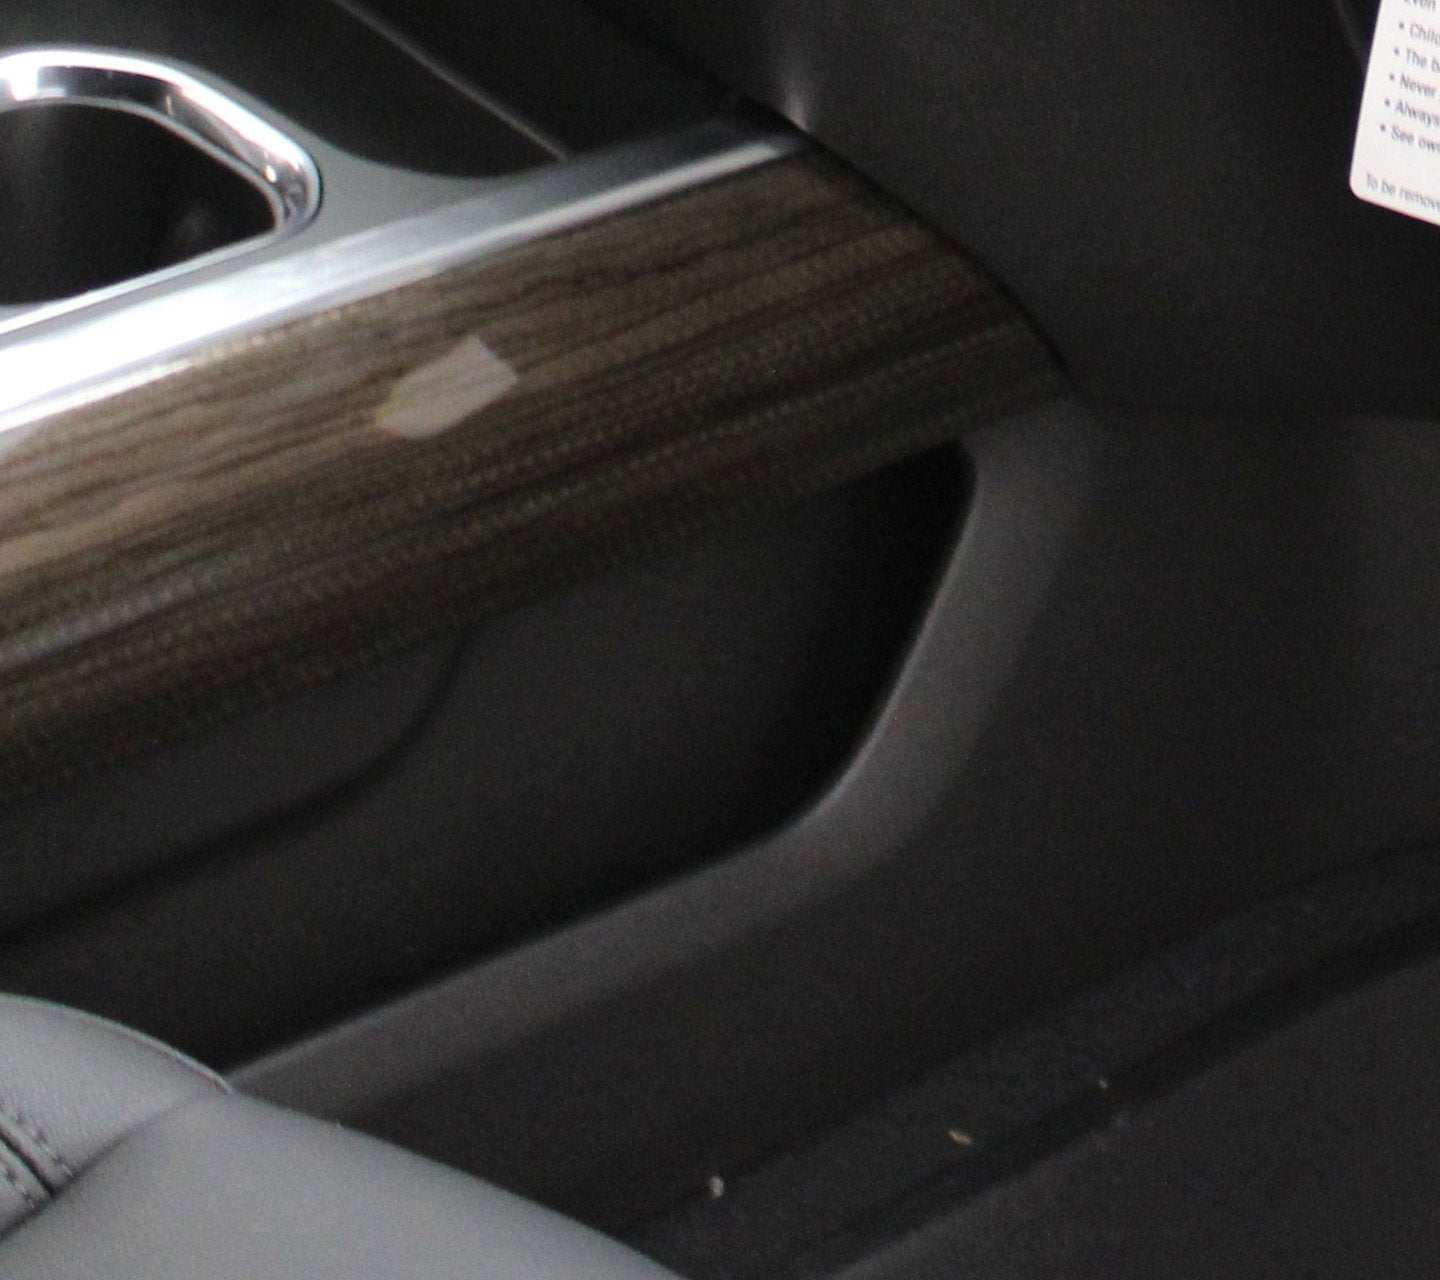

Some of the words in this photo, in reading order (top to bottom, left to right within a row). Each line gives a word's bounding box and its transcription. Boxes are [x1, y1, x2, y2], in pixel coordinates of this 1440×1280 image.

[1406, 48, 1427, 68] The
[1399, 73, 1436, 97] Never
[1395, 100, 1440, 126] Always
[1390, 124, 1414, 145] See
